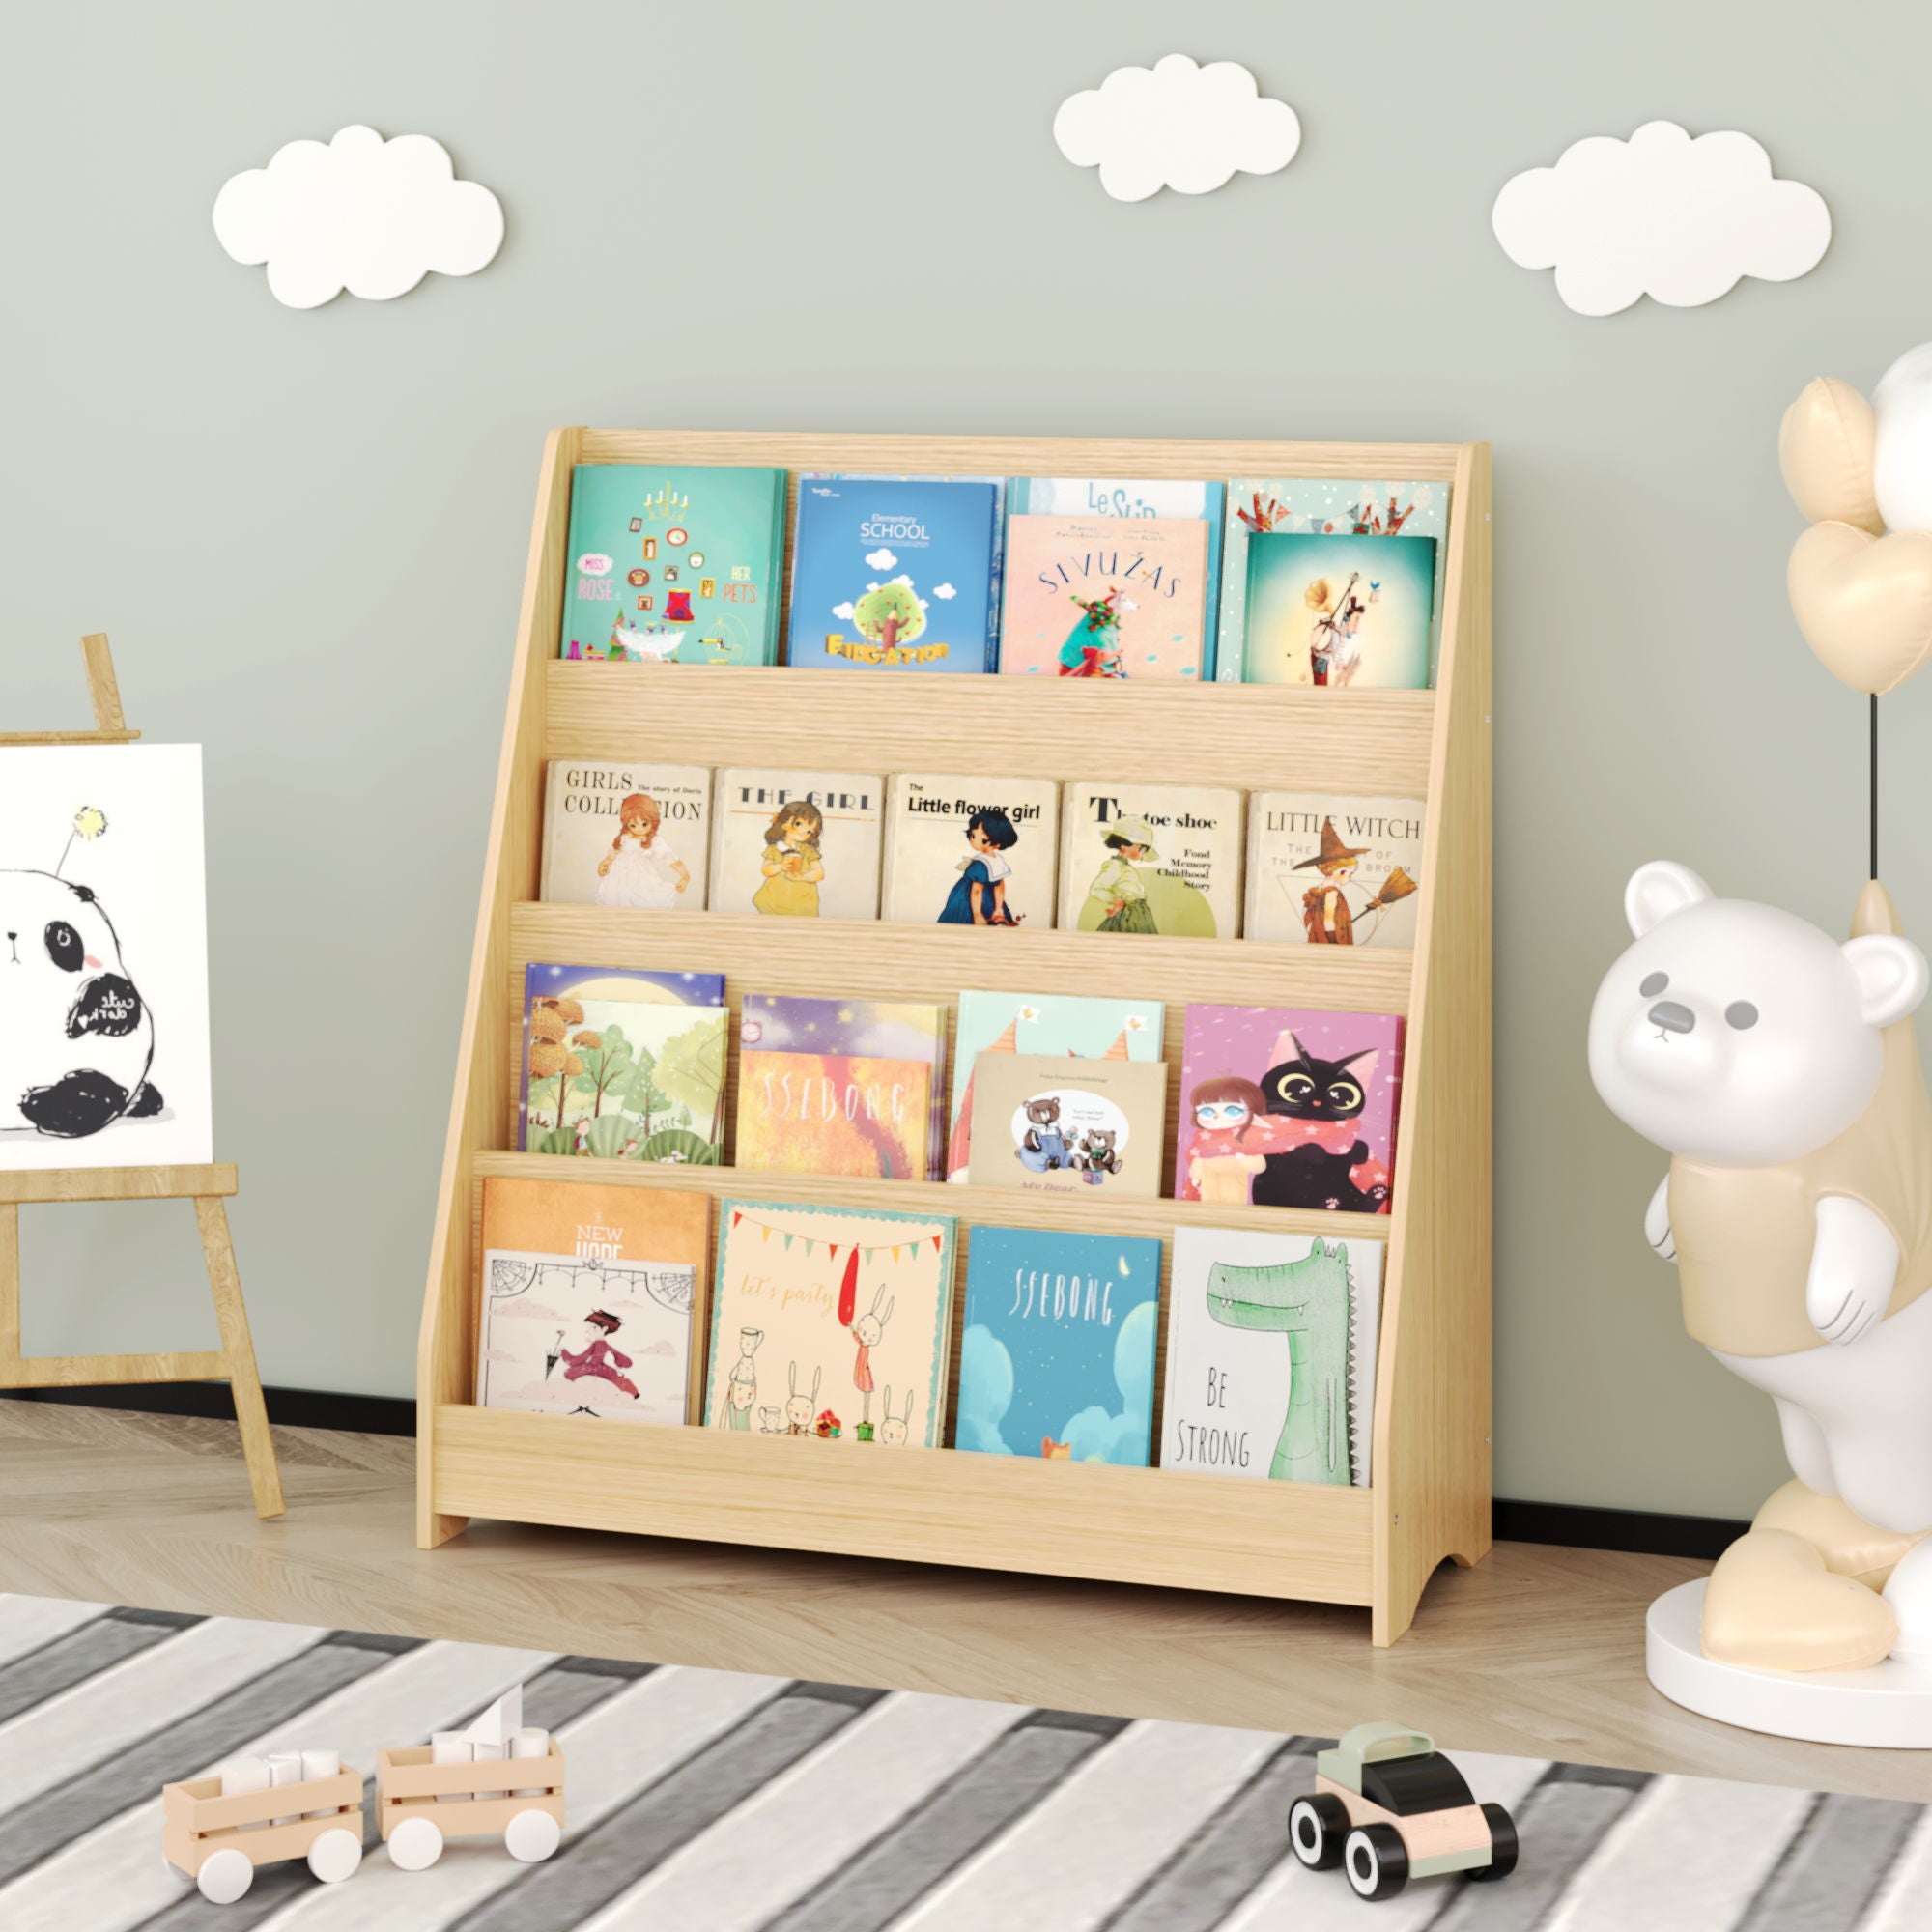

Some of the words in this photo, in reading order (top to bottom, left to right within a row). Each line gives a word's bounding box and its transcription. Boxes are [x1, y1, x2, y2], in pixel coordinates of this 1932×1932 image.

[1089, 482, 1108, 514] Le
[871, 513, 917, 525] Elementary
[860, 522, 930, 540] SCHOOL
[584, 558, 604, 571] MISS
[731, 566, 751, 581] HER
[1038, 550, 1181, 598] SIVUŽAS
[578, 578, 614, 601] ROSE
[722, 582, 757, 604] PETS
[566, 770, 633, 791] GIRLS
[565, 794, 702, 820] COLLION
[738, 786, 793, 805] THE
[806, 791, 875, 811] GIRL
[908, 797, 951, 813] Little
[1012, 804, 1040, 822] girl
[1143, 811, 1171, 827] toe
[1175, 813, 1217, 829] shoe
[1346, 816, 1420, 839] WITCH
[1183, 848, 1210, 859] Fond
[1271, 857, 1295, 867] THE
[1287, 843, 1312, 855] THE
[1376, 851, 1392, 860] OF
[1157, 867, 1209, 879] Childhood
[1170, 858, 1212, 869] Memory
[1183, 880, 1211, 893] Story
[759, 1072, 907, 1123] SSEBONG
[577, 1224, 624, 1242] NEW
[1008, 1268, 1114, 1327] SSEBONG
[1207, 1366, 1228, 1408] BE
[1175, 1419, 1251, 1468] STRONG
